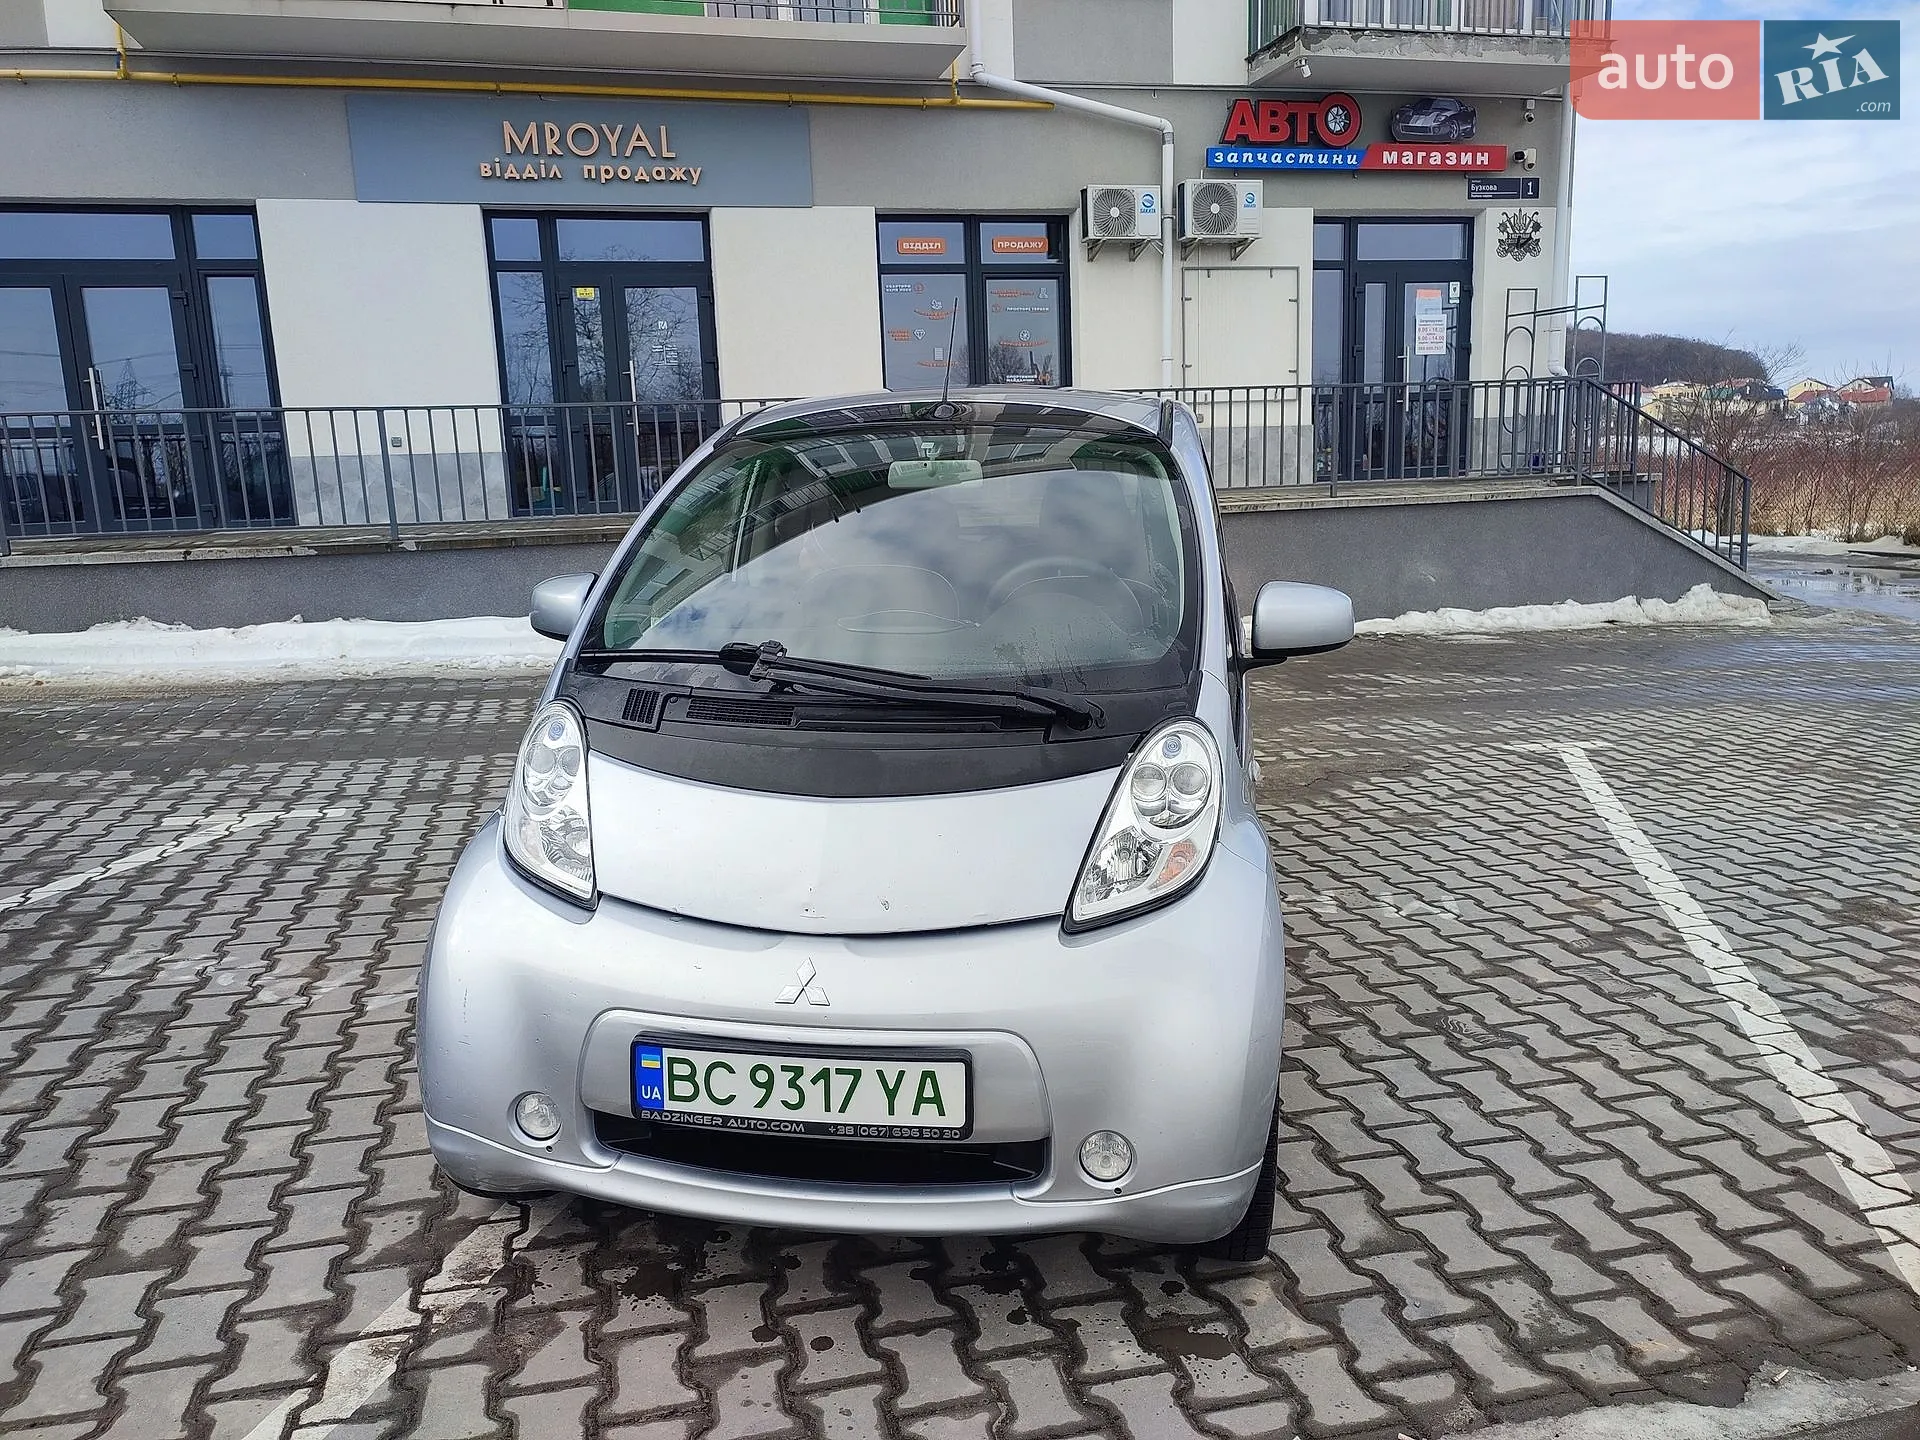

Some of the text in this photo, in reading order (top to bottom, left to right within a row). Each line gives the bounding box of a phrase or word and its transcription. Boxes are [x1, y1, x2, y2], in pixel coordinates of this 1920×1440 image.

[1221, 92, 1361, 147] АВТО
[502, 120, 677, 159] MROYAL
[1213, 149, 1490, 167] запчастини магазин
[479, 158, 702, 186] відділ продажу
[1471, 181, 1534, 195] Бузкова 1
[903, 241, 1044, 250] ВІДДІЛ ПРОДАЖУ
[642, 1056, 946, 1117] UA BC 9317 YA
[641, 1111, 805, 1133] BADZINGER AUTO.COM
[829, 1126, 960, 1139] +38 (067) 696 50 30
